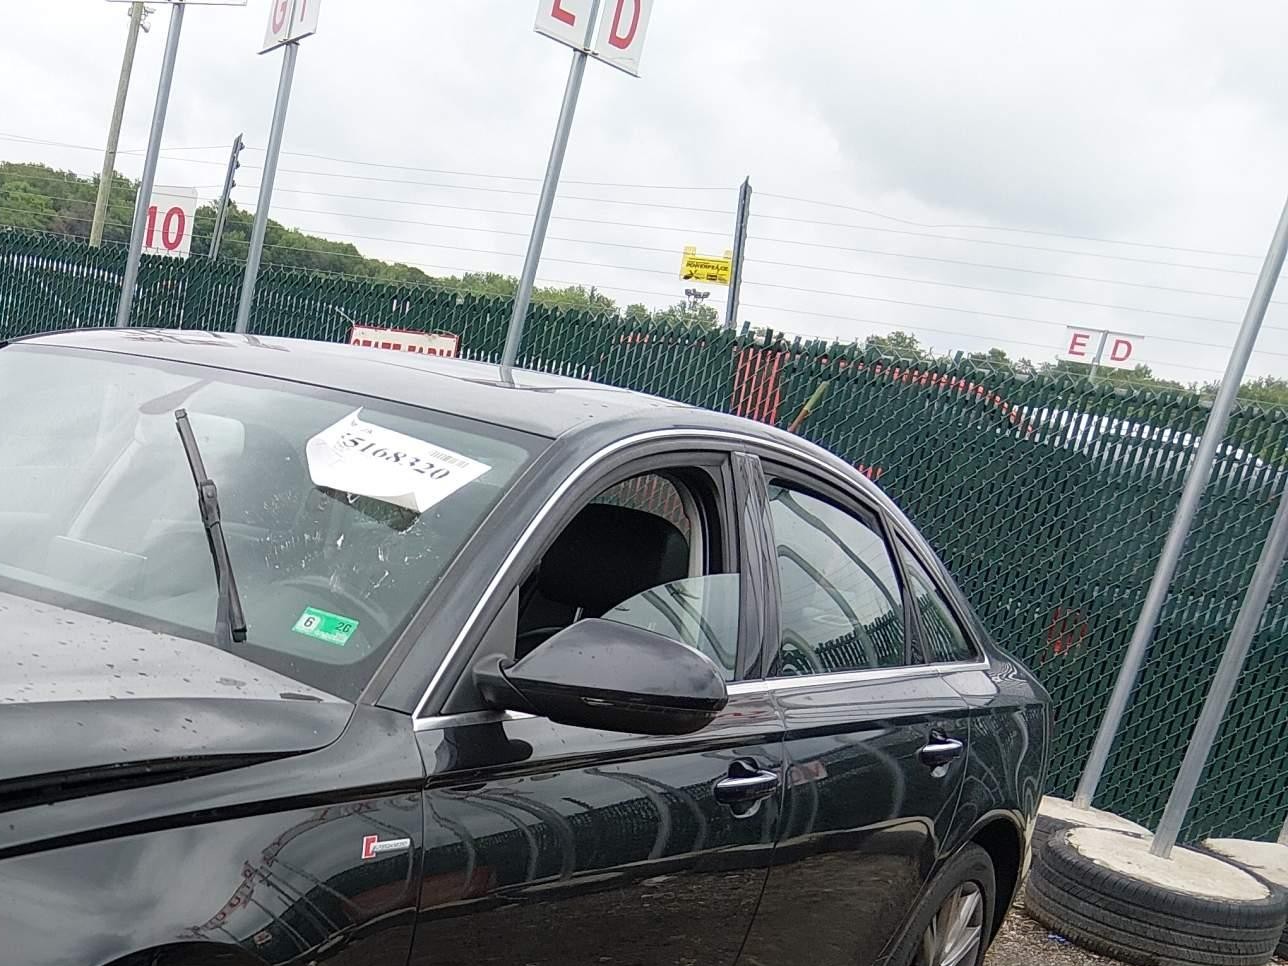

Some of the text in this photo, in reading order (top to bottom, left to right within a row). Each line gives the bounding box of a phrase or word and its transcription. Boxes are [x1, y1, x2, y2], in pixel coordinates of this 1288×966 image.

[146, 206, 186, 251] 10
[1068, 333, 1133, 361] E D
[339, 431, 451, 480] 5168320
[304, 617, 352, 633] 6 26
